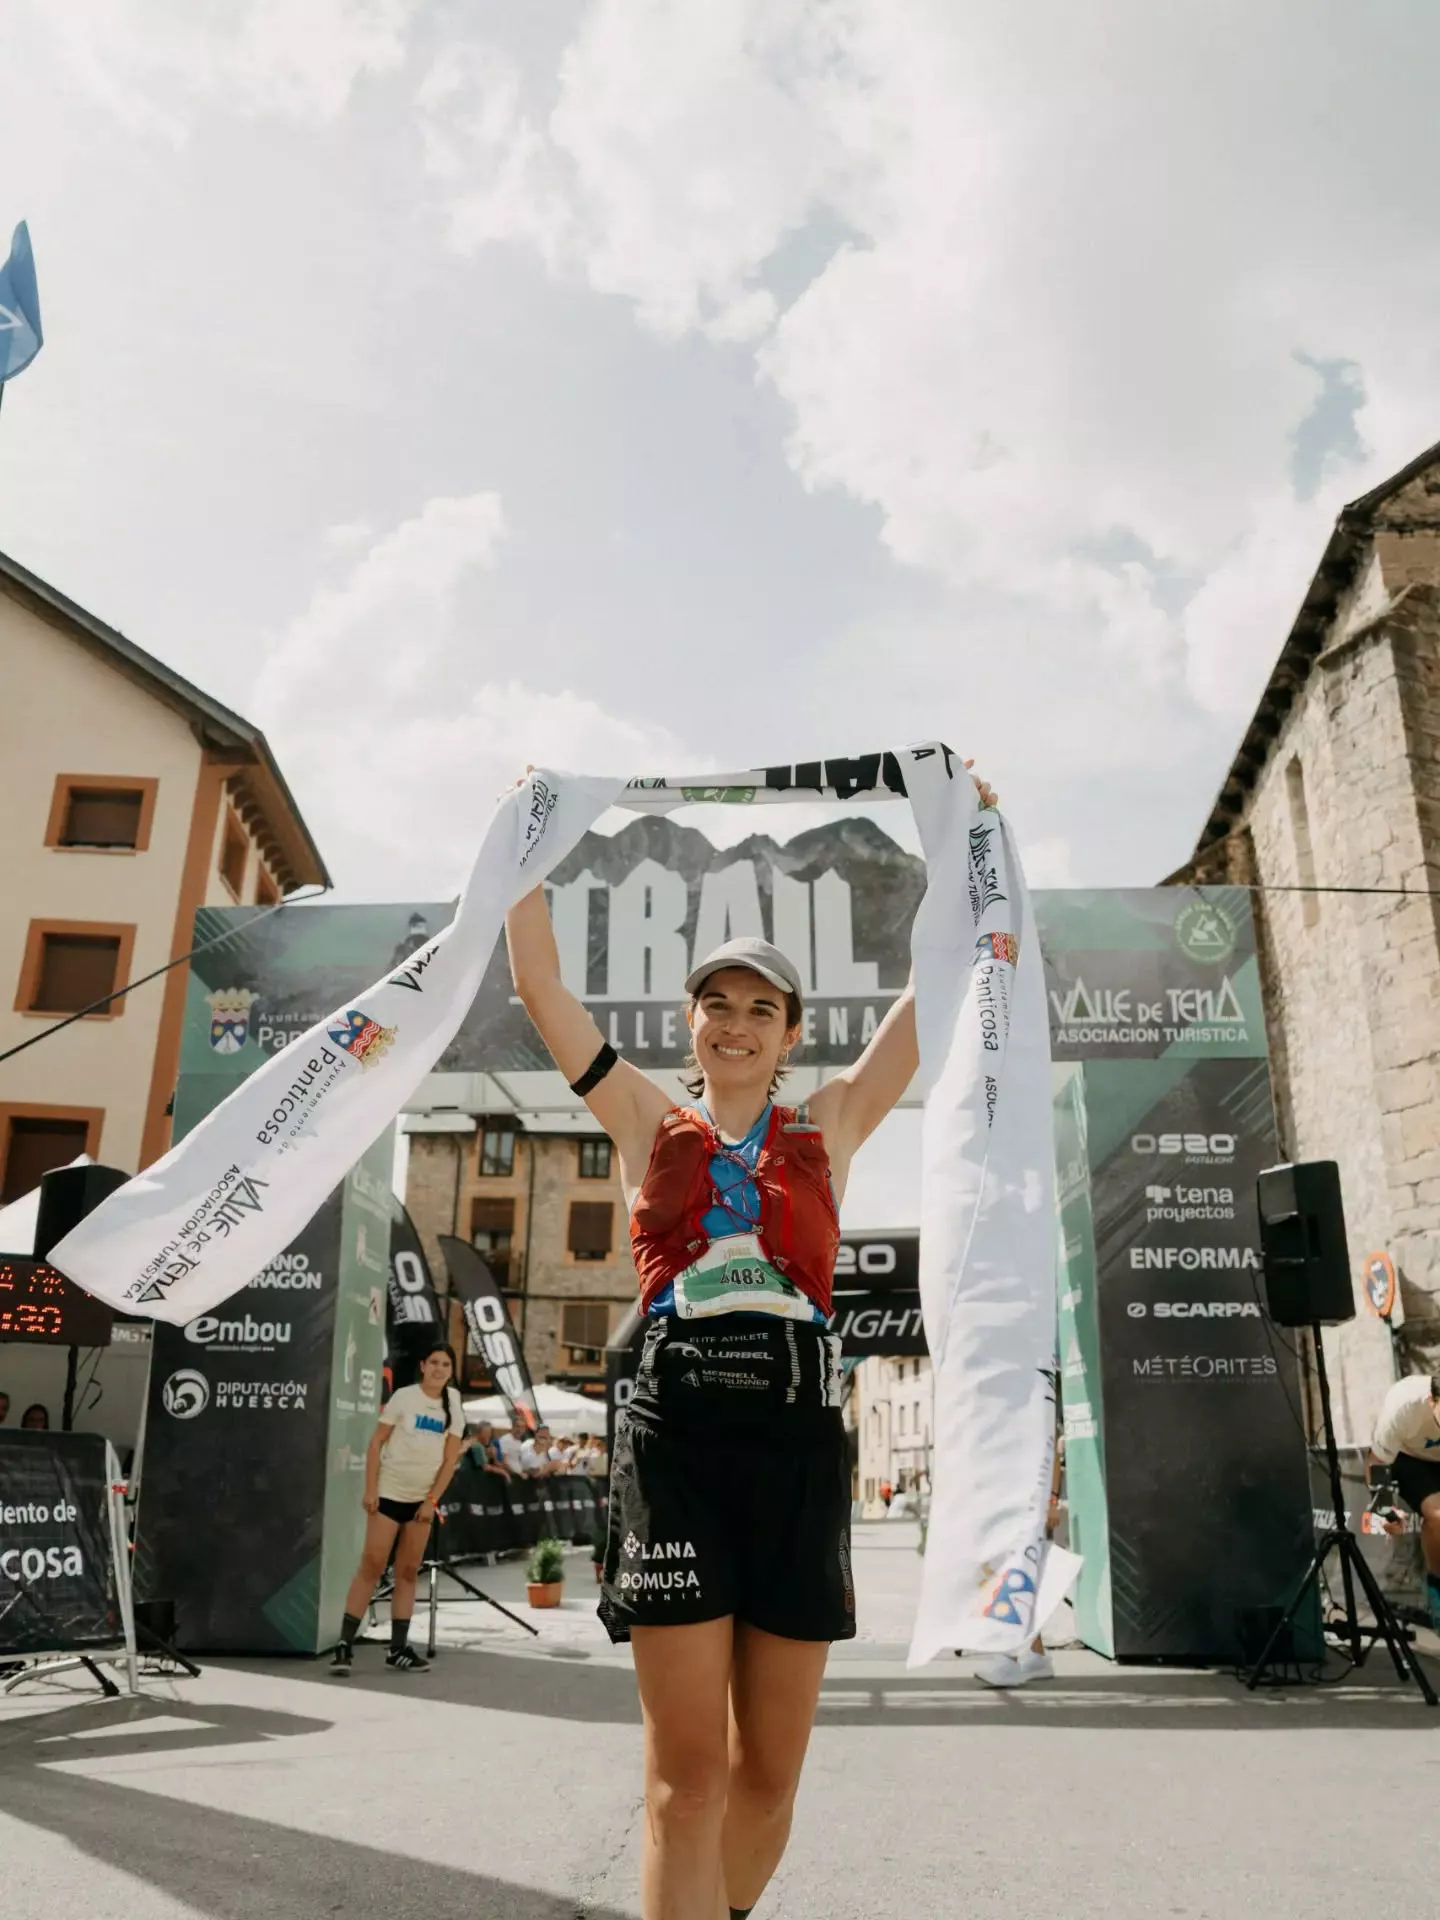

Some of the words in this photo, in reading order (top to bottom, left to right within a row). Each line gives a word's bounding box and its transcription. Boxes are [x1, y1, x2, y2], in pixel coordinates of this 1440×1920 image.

[542, 857, 880, 1001] TRAIL
[258, 1012, 326, 1025] Ayuntam
[975, 965, 1000, 1052] Panticosa
[609, 1010, 677, 1049] LLE
[801, 1006, 880, 1046] ENA
[1056, 1027, 1159, 1044] ASOCIACION
[1163, 1026, 1249, 1043] TURISTICA
[256, 1046, 337, 1145] Panticosa
[290, 1061, 348, 1138] Ayuntamiento
[178, 1163, 241, 1242] ASOCIACION
[1174, 1184, 1233, 1204] tena
[1147, 1206, 1235, 1223] proyectos
[1130, 1247, 1259, 1270] ENFORMA
[122, 1240, 181, 1300] TURISTICA
[1153, 1302, 1262, 1318] SCARPA
[184, 1313, 292, 1344] embou
[721, 1332, 769, 1343] ATHLETE
[707, 1349, 774, 1360] LURBEL
[217, 1380, 308, 1396] DIPUTACIÓN
[216, 1395, 306, 1409] HUESCA
[0, 1501, 49, 1525] iento
[53, 1498, 77, 1523] de
[641, 1541, 697, 1559] LANA
[0, 1546, 83, 1581] cosa
[620, 1570, 700, 1590] DOMUSA
